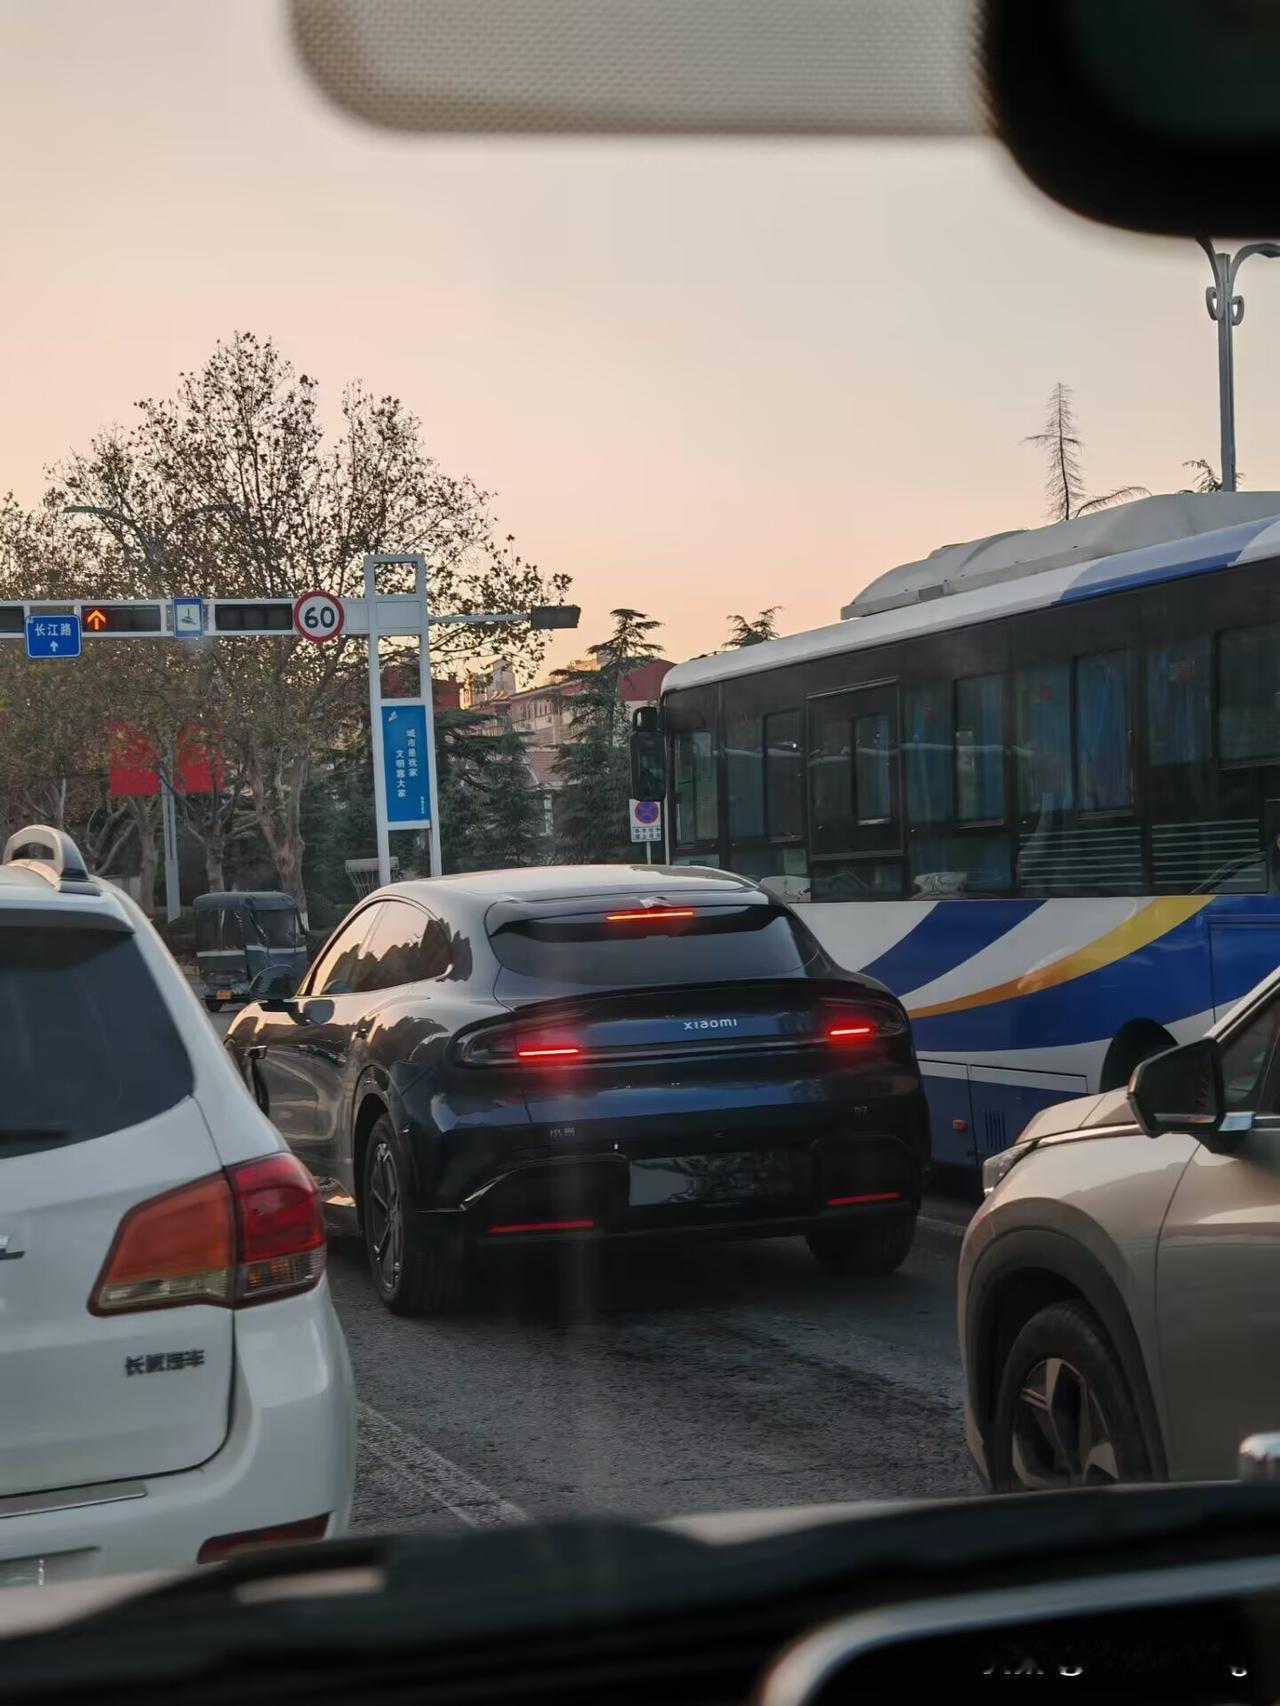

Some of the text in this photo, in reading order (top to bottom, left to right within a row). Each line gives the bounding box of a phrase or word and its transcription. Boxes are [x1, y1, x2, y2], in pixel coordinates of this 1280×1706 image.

[304, 606, 336, 629] 60
[34, 622, 72, 637] 长江路
[682, 1018, 738, 1031] xiaomi
